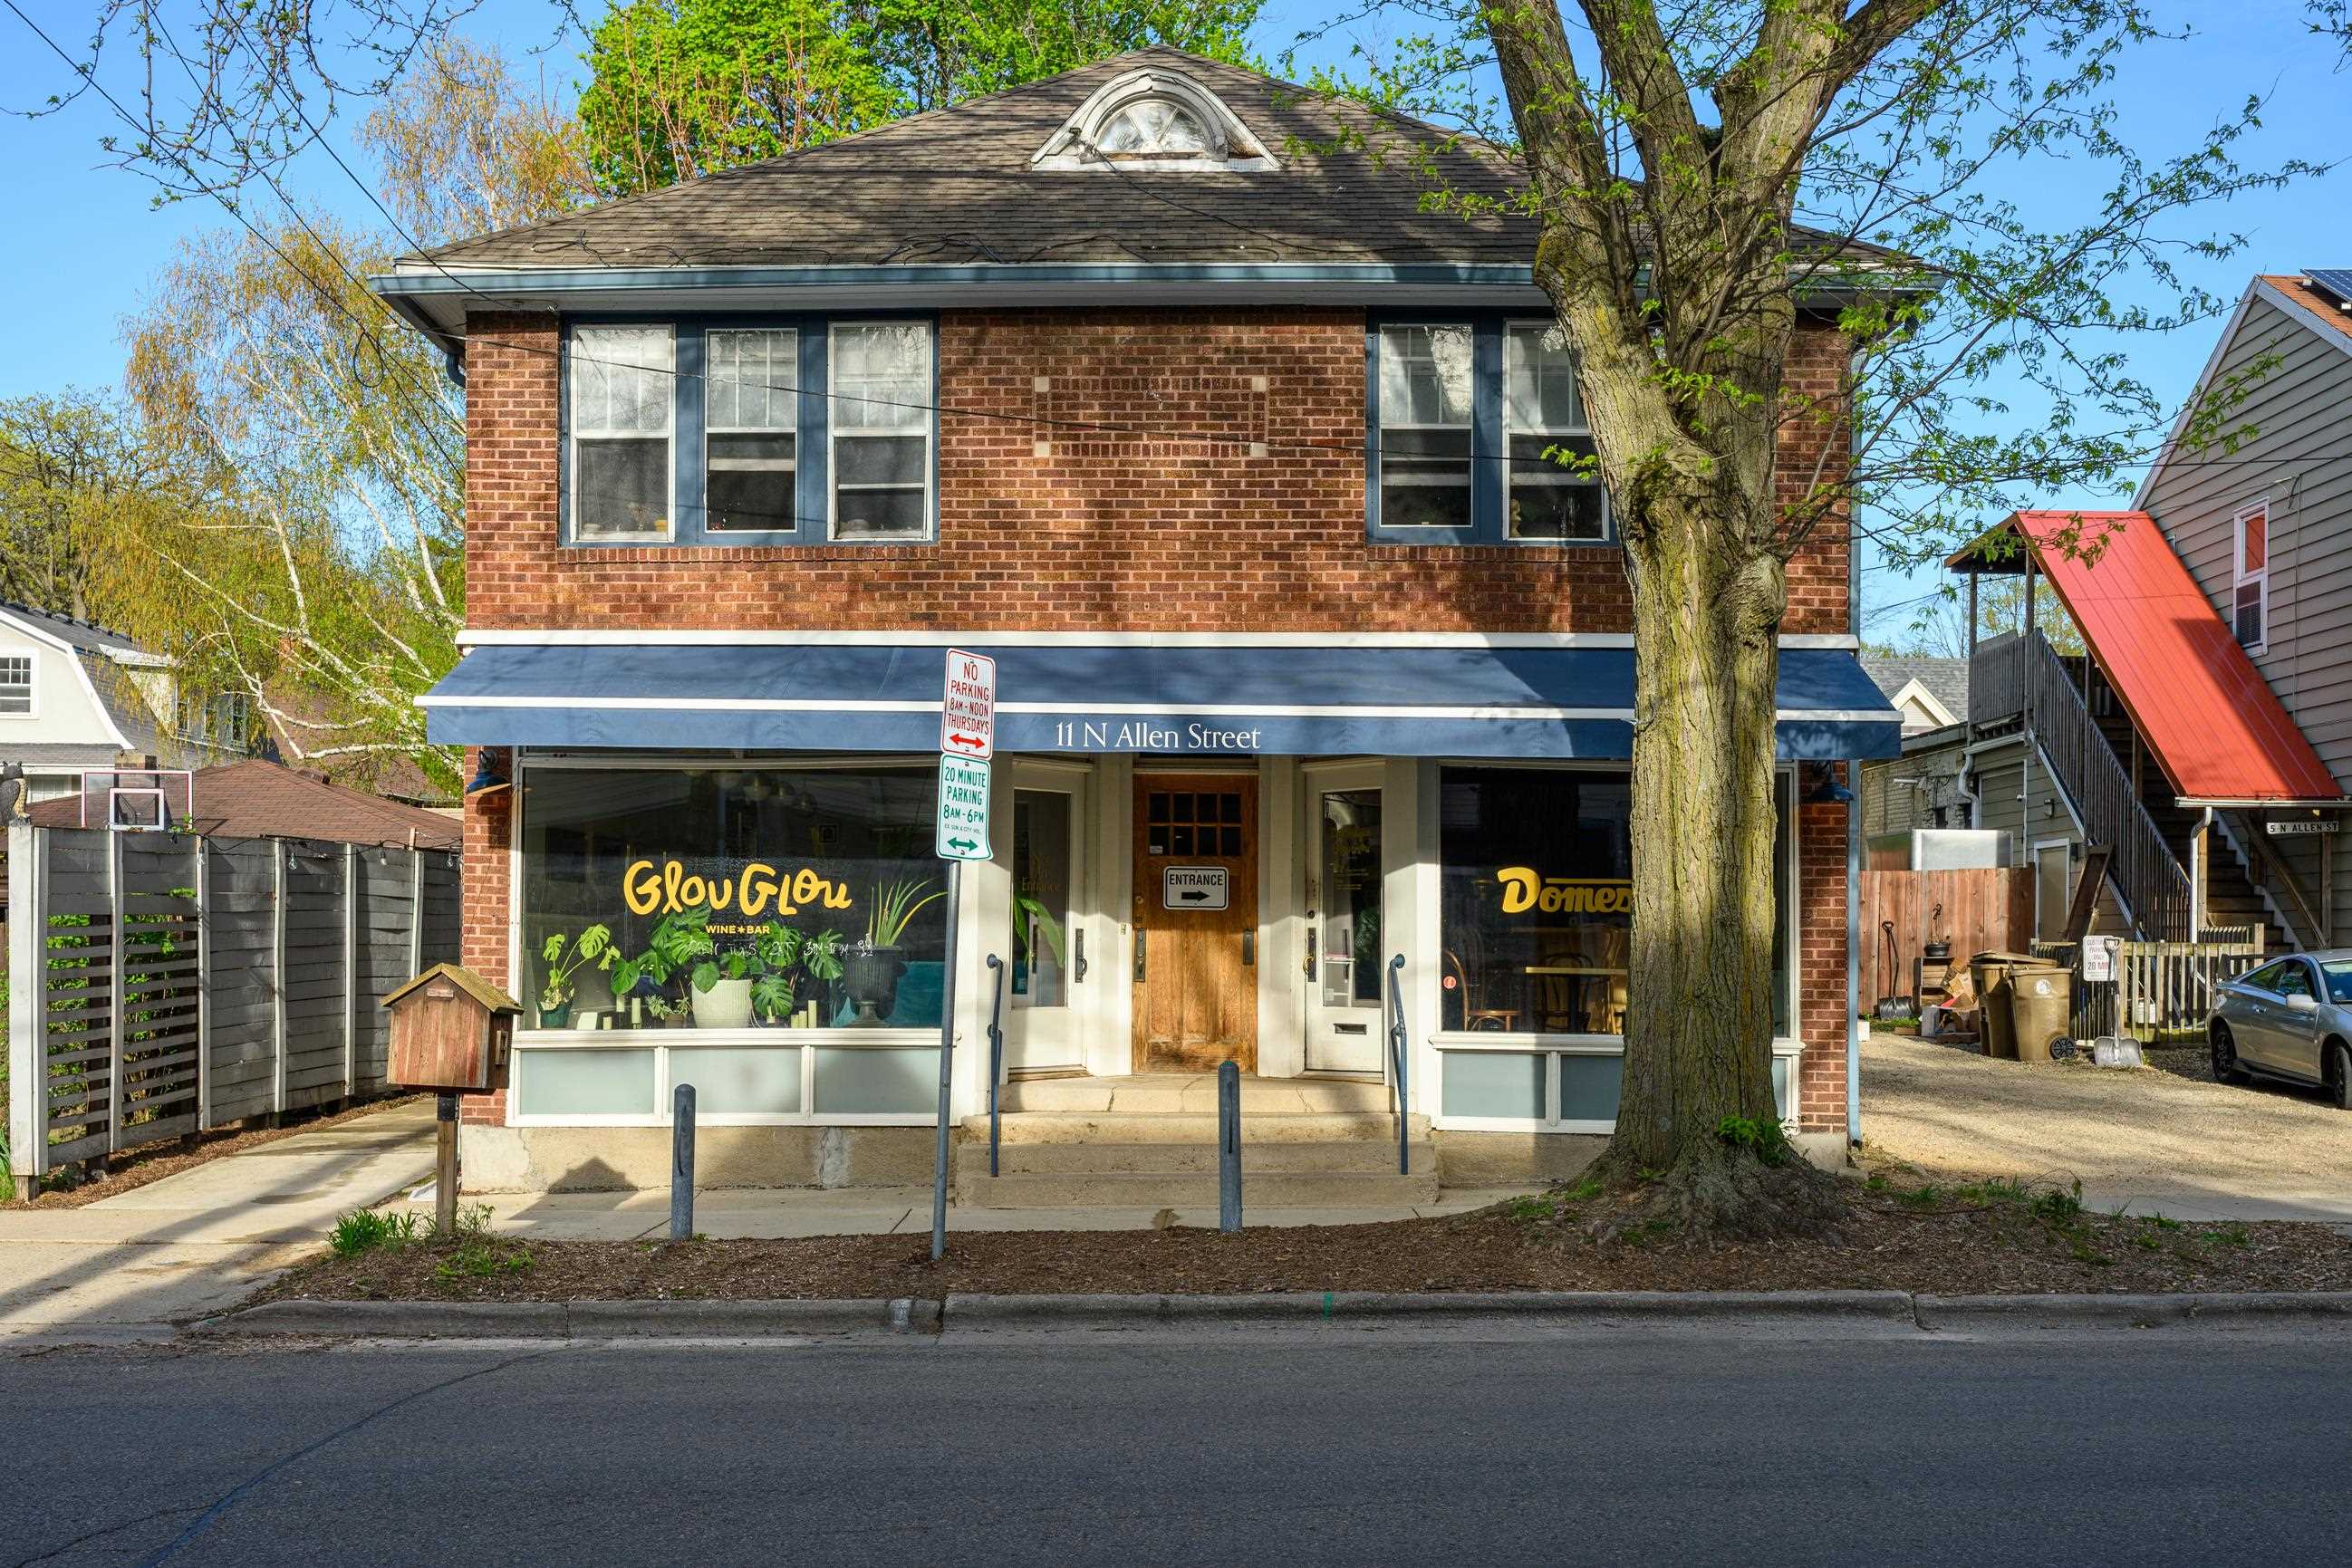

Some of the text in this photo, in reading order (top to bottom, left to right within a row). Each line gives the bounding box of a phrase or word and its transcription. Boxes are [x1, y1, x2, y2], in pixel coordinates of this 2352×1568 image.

[963, 662, 978, 681] NO
[950, 679, 989, 701] PARKING
[948, 713, 989, 736] THURSDAYS
[1056, 722, 1261, 749] 11 N Allen Street
[944, 766, 987, 788] 20 MINUTE
[947, 785, 982, 805] PARKING
[2280, 824, 2287, 832] N
[2292, 823, 2322, 832] ALLEN
[2326, 822, 2338, 832] ST
[1169, 874, 1223, 886] ENTRANCE
[705, 925, 770, 934] WINE BAR
[2087, 961, 2097, 970] 20
